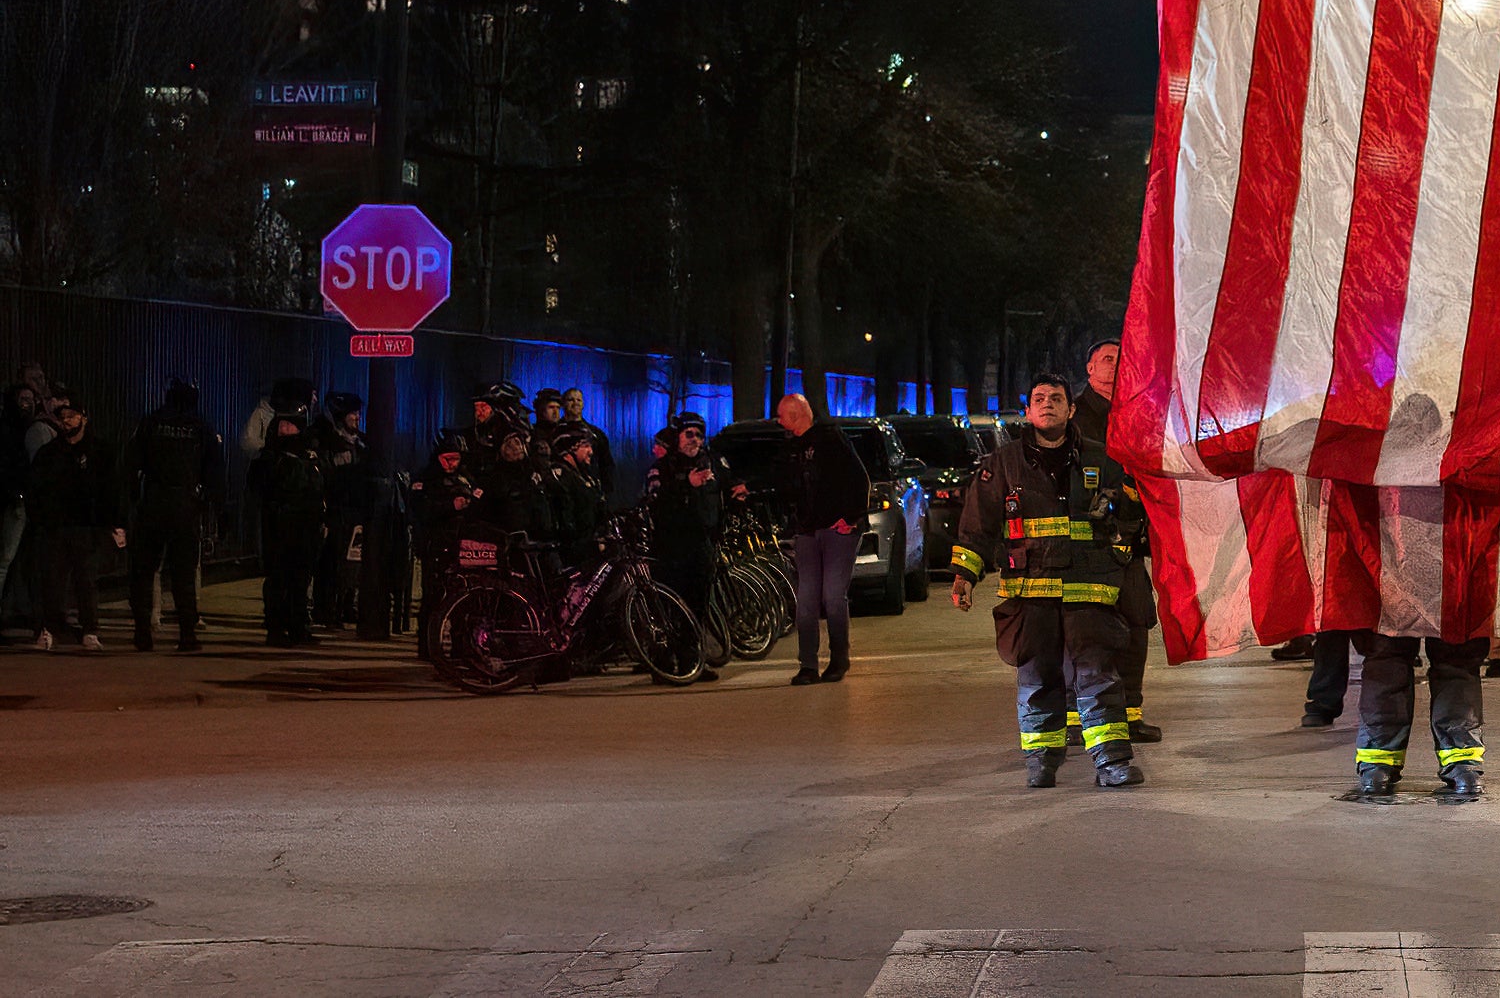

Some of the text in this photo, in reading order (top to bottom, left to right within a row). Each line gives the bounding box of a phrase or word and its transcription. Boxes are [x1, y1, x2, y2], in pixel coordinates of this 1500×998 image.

[270, 84, 349, 103] LEAVITT
[254, 129, 295, 142] WILLIAM
[312, 129, 351, 143] BRADEN
[331, 244, 441, 291] STOP
[357, 339, 407, 352] ALL WAY
[459, 548, 497, 560] POLICE
